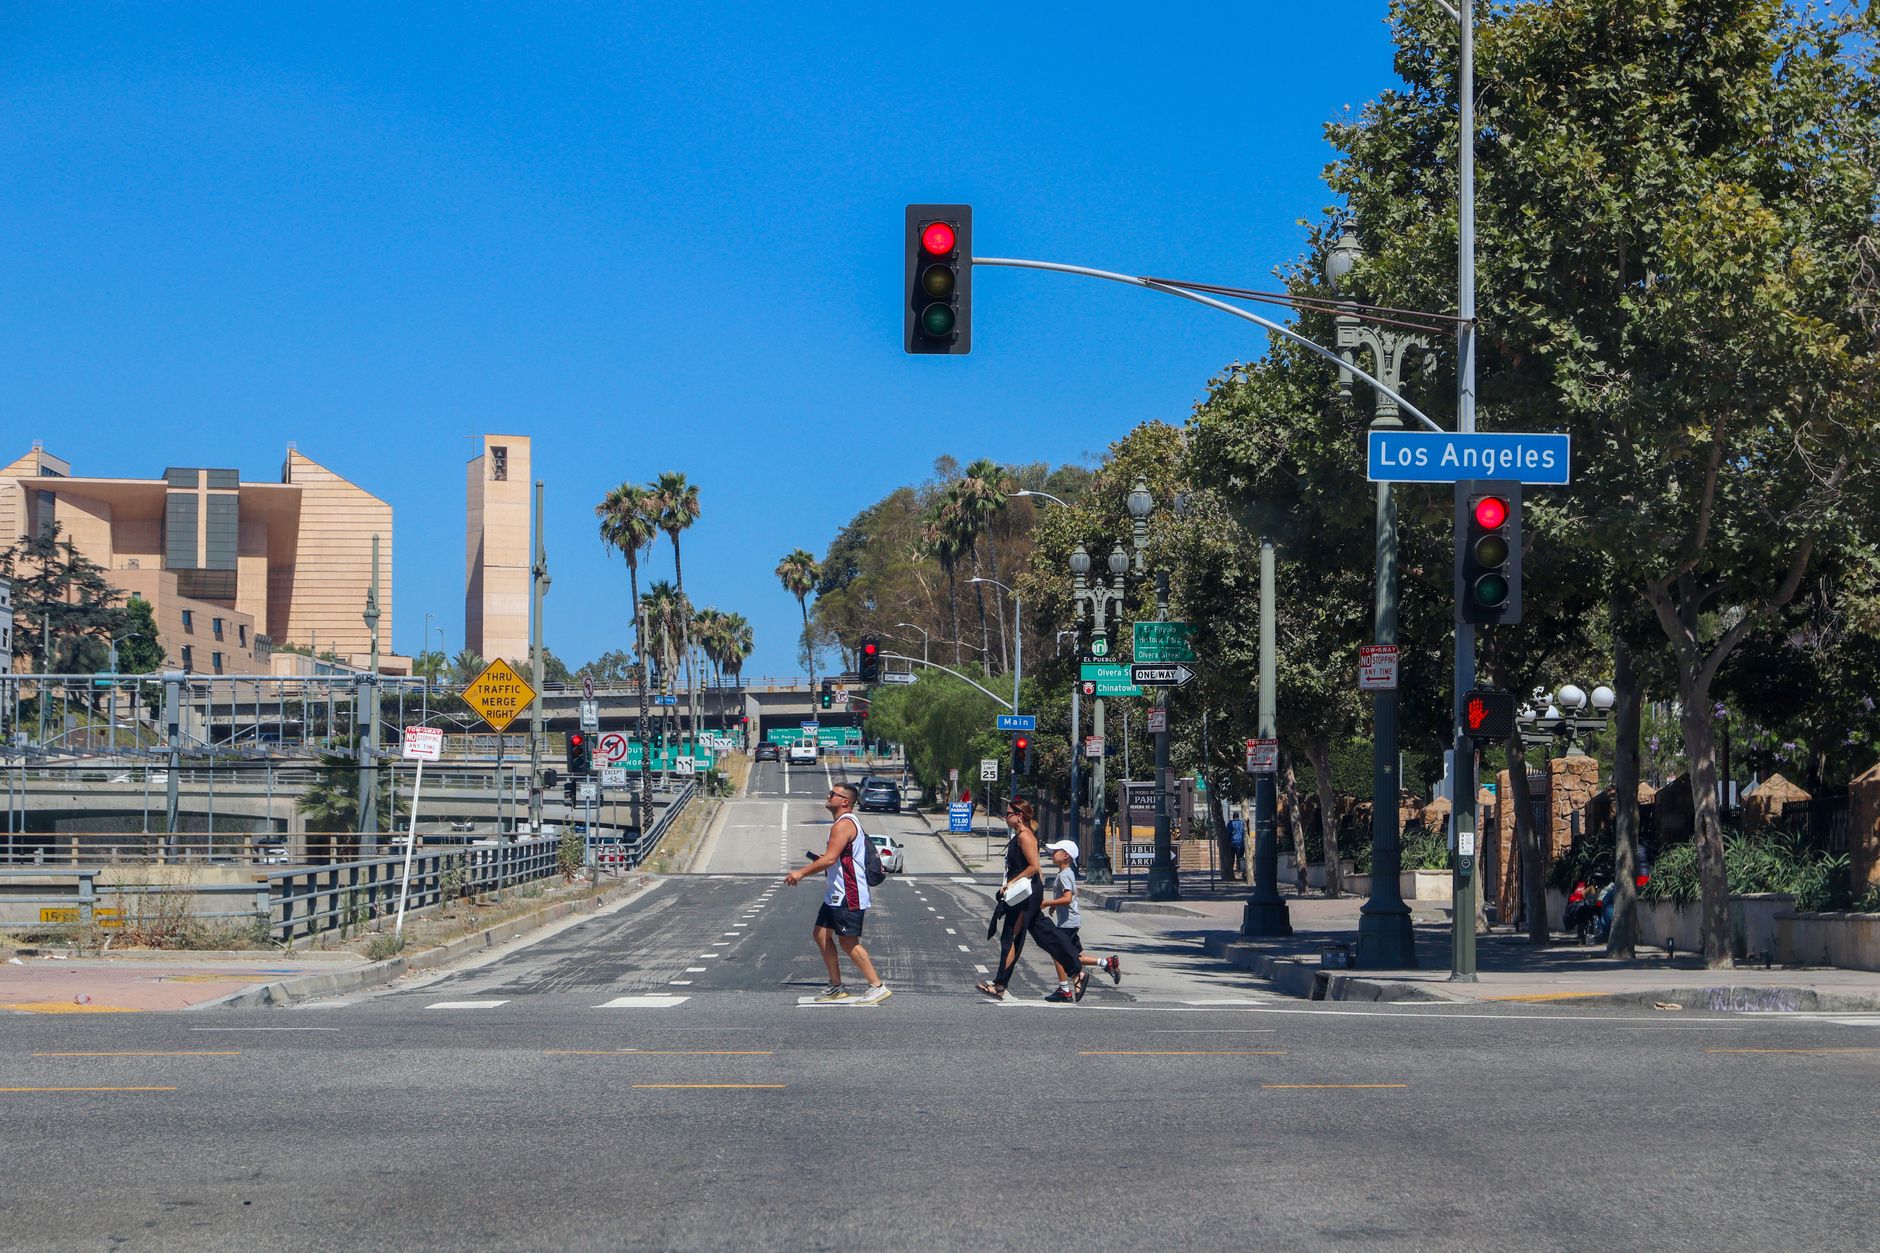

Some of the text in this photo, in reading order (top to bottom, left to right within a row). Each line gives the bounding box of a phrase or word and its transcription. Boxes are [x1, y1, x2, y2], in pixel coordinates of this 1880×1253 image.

[1380, 441, 1555, 476] Los Angeles
[1138, 650, 1159, 659] Olvera
[1361, 655, 1396, 667] NO STOPPING
[1097, 668, 1122, 677] Olvera
[1137, 670, 1176, 679] ONE WAY
[1364, 667, 1393, 676] ANY TIME
[486, 672, 512, 682] THRU
[477, 684, 521, 694] TRAFFIC
[1097, 683, 1137, 692] Chinatown
[481, 697, 516, 706] MERGE
[486, 709, 514, 719] RIGHT
[1003, 718, 1029, 726] Main
[406, 733, 416, 741] NO
[982, 770, 996, 779] 25
